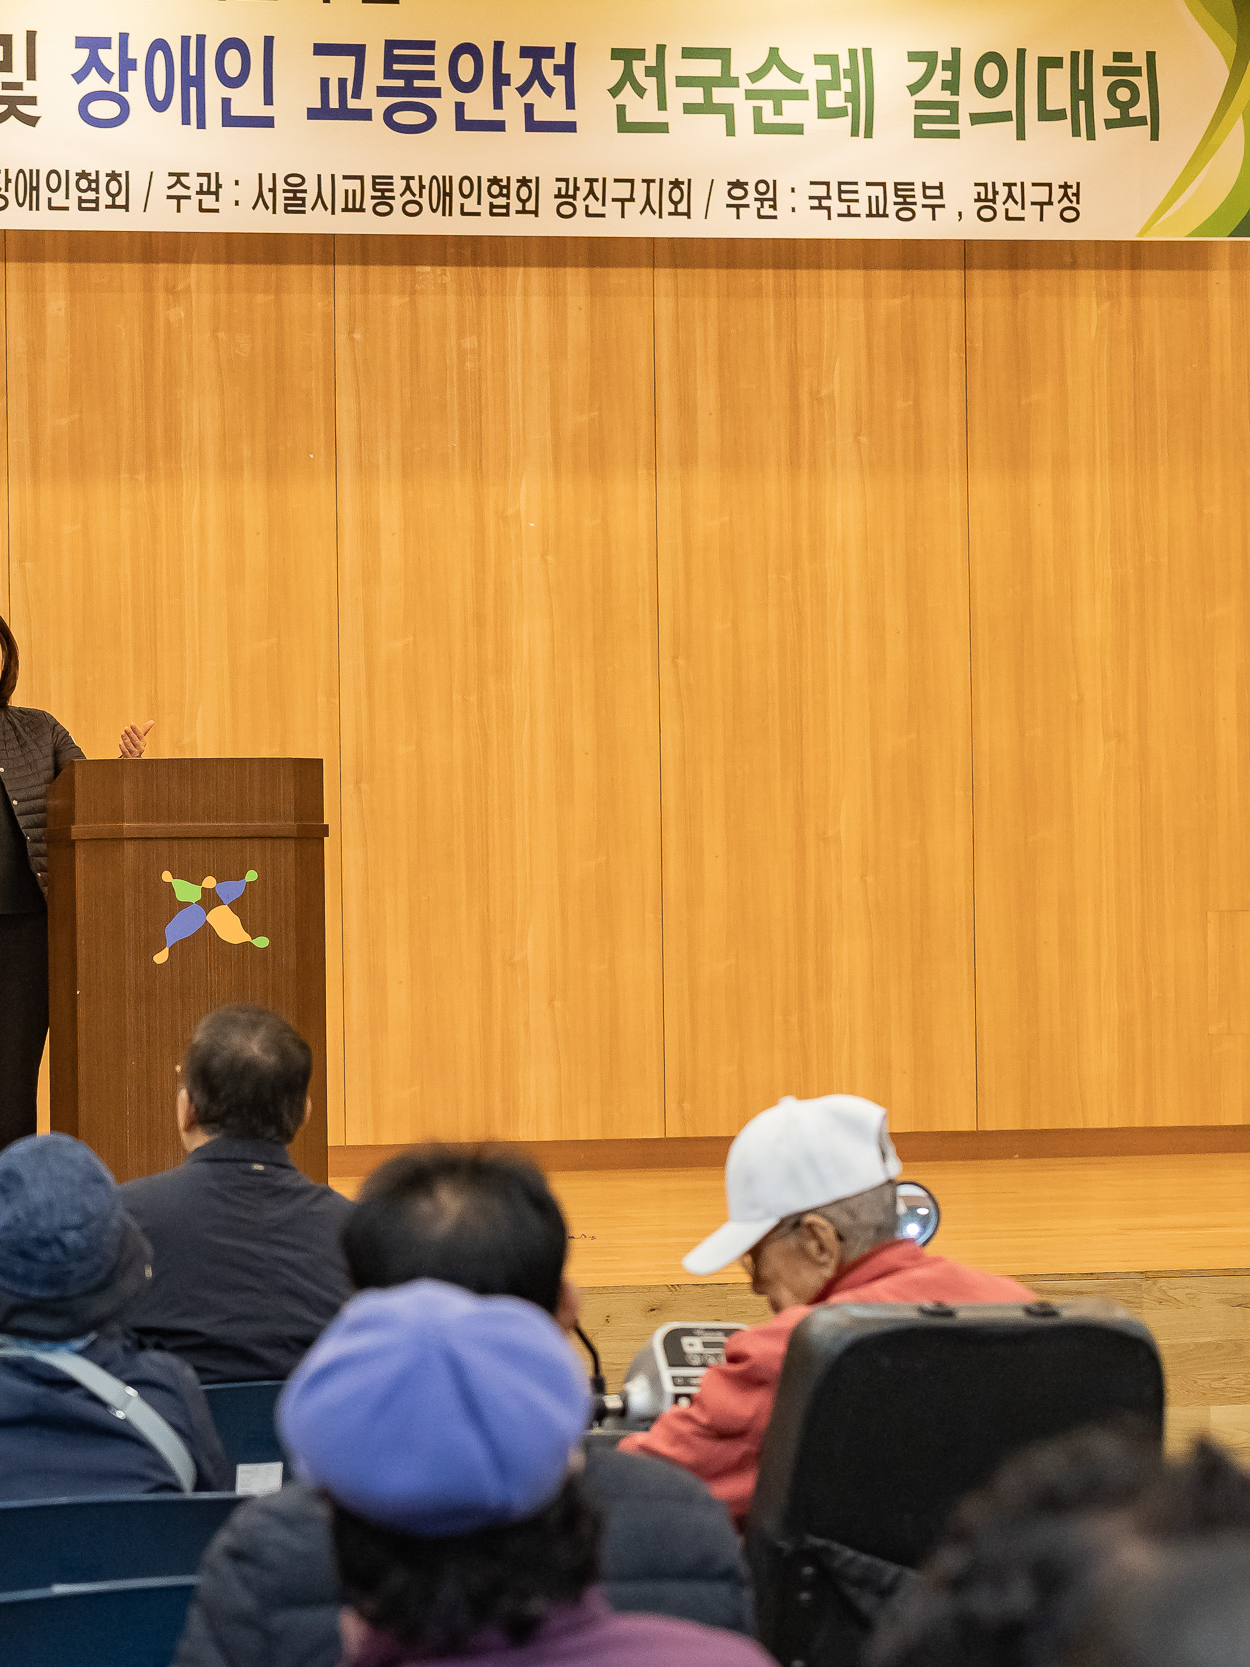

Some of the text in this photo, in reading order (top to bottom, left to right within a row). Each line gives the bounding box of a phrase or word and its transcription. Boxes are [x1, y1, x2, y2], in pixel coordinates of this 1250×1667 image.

[71, 32, 275, 129] 장애인
[307, 39, 577, 134] 교통안전
[606, 44, 874, 138] 전국순례
[907, 47, 1159, 141] 결의대회
[166, 172, 222, 213] 주관
[252, 173, 540, 218] 서울시교통장애인협회
[554, 177, 692, 219] 광진구지회
[726, 179, 778, 220] 후원
[808, 181, 946, 222] 국토교통부
[974, 181, 1080, 223] 광진구청
